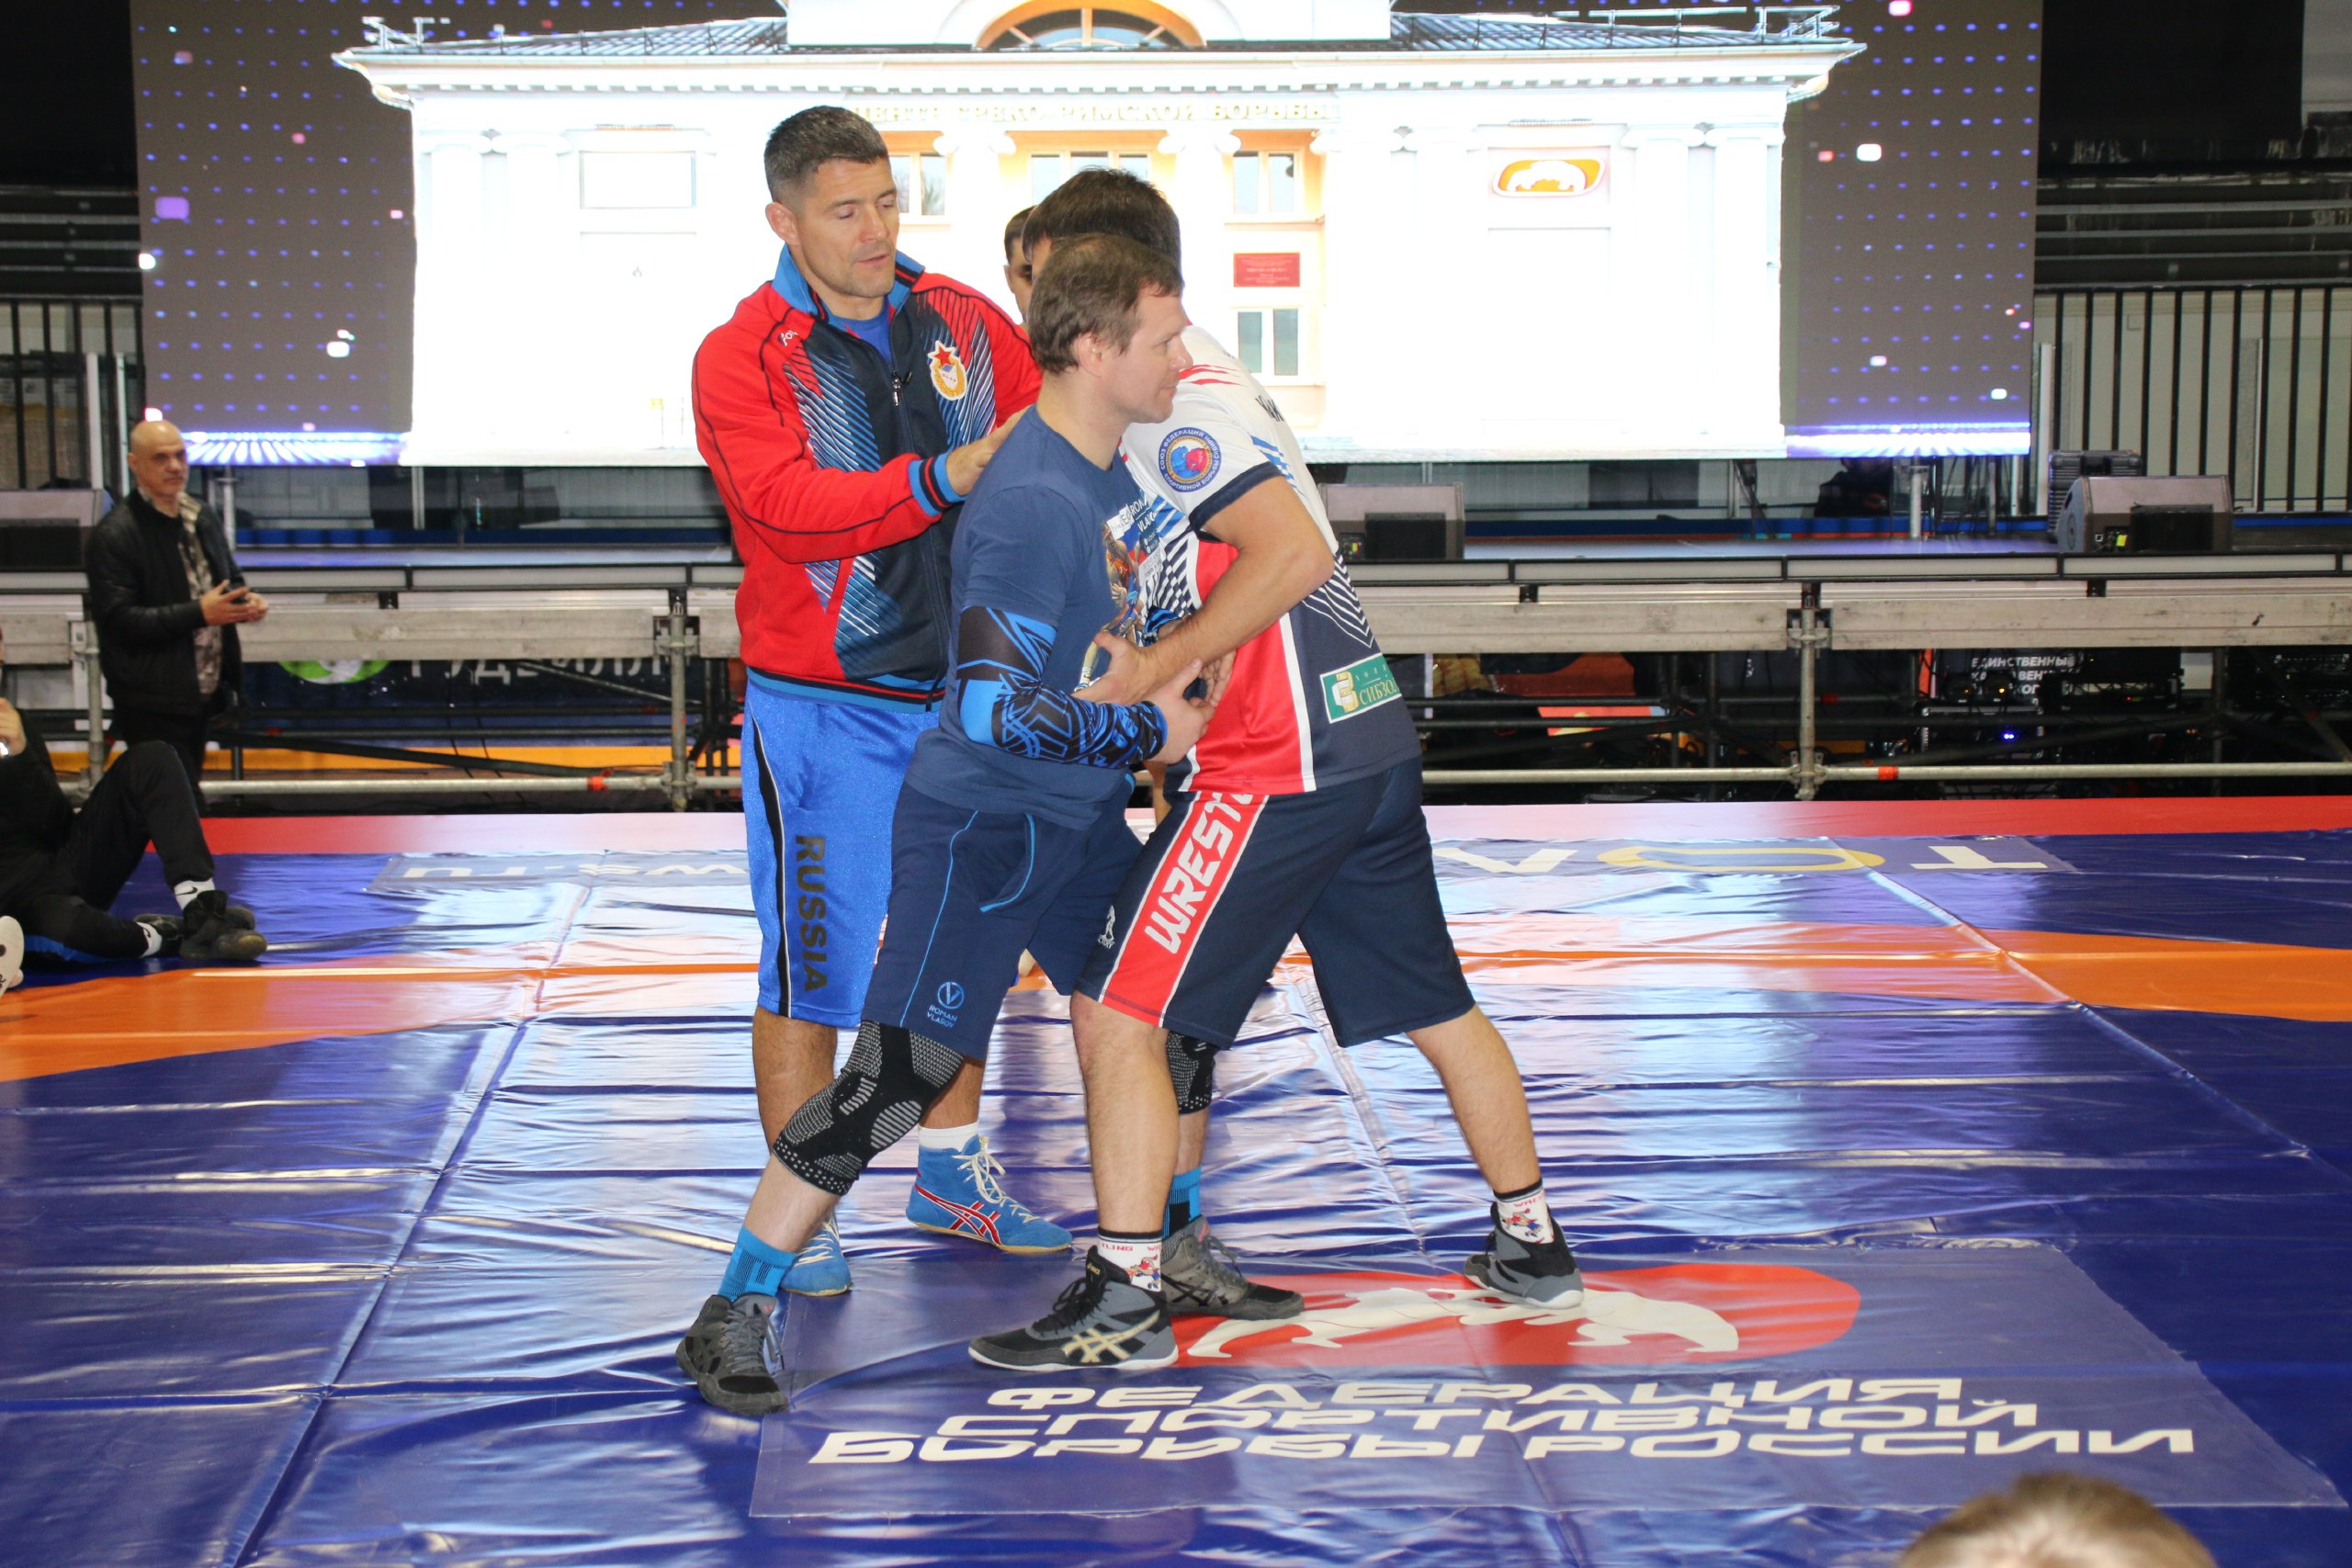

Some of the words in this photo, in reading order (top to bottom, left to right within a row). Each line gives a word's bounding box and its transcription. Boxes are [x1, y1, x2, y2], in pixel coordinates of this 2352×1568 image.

[794, 835, 828, 992] RUSSIA
[928, 1005, 957, 1022] ROMAN
[987, 1377, 1962, 1411] ФЕДЕРАЦИЯ
[936, 1399, 2038, 1436] СПОРТИВНОЙ
[808, 1431, 1486, 1464] БОРЬБЫ
[1523, 1429, 2195, 1460] РОССИИ
